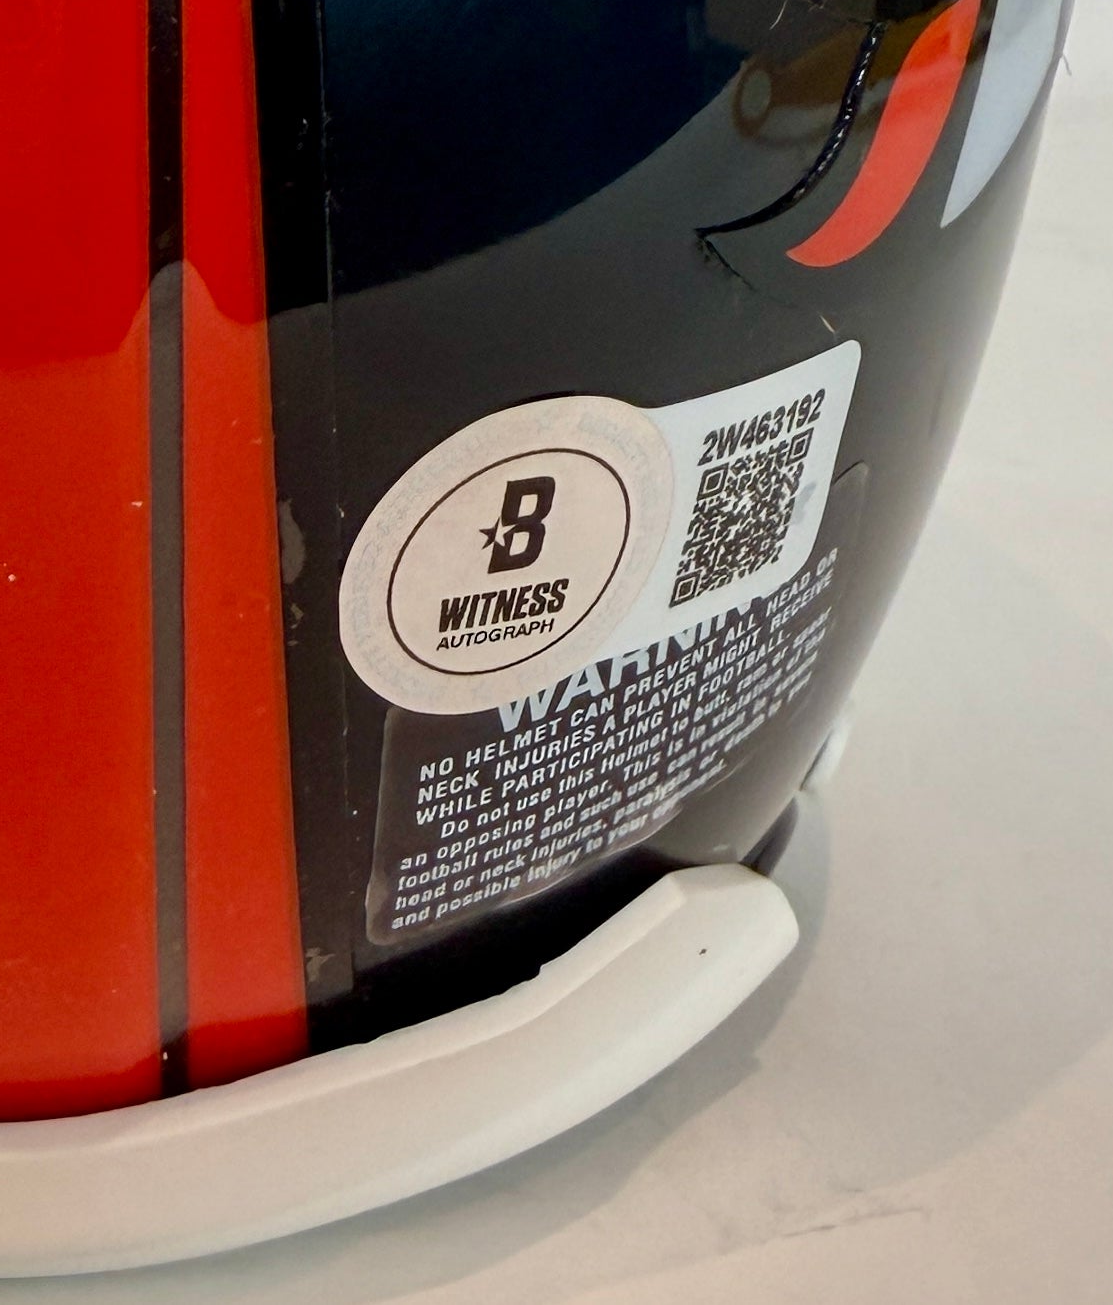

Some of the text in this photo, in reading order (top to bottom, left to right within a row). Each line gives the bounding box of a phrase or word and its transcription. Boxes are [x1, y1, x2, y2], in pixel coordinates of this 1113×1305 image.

[697, 388, 826, 467] 2W463192
[486, 475, 556, 574] B
[436, 618, 555, 651] AUTOGRAPH
[439, 578, 570, 633] WITNESS
[418, 770, 480, 804] NECK
[495, 725, 596, 780] INJURIES
[602, 715, 616, 735] A
[623, 671, 697, 724] PLAYER
[703, 626, 763, 679] MIGHT
[769, 568, 834, 633] RECEIVE
[420, 547, 838, 781] NO HELMET CAN PREVENT ALL HEAD OR
[416, 787, 493, 825] WHILE
[502, 710, 663, 798] PARTICIPATING
[671, 694, 692, 718] IN
[698, 629, 792, 702] FOOTBALL.
[400, 852, 427, 870] an
[437, 813, 536, 860] opposing
[543, 780, 613, 823] player.
[623, 751, 662, 782] This
[667, 738, 683, 757] is
[441, 818, 469, 839] Do
[477, 802, 509, 826] not
[516, 787, 552, 811] use
[558, 767, 594, 794] this
[601, 727, 668, 774] Helmet
[672, 716, 689, 735] to
[392, 906, 430, 930] and
[435, 875, 521, 919] possible
[527, 846, 582, 883] injury
[395, 881, 447, 911] head
[453, 875, 475, 892] or
[480, 853, 527, 882] neck
[397, 855, 477, 891] football
[483, 833, 534, 863] rules
[540, 812, 574, 839] and
[579, 790, 623, 822] such
